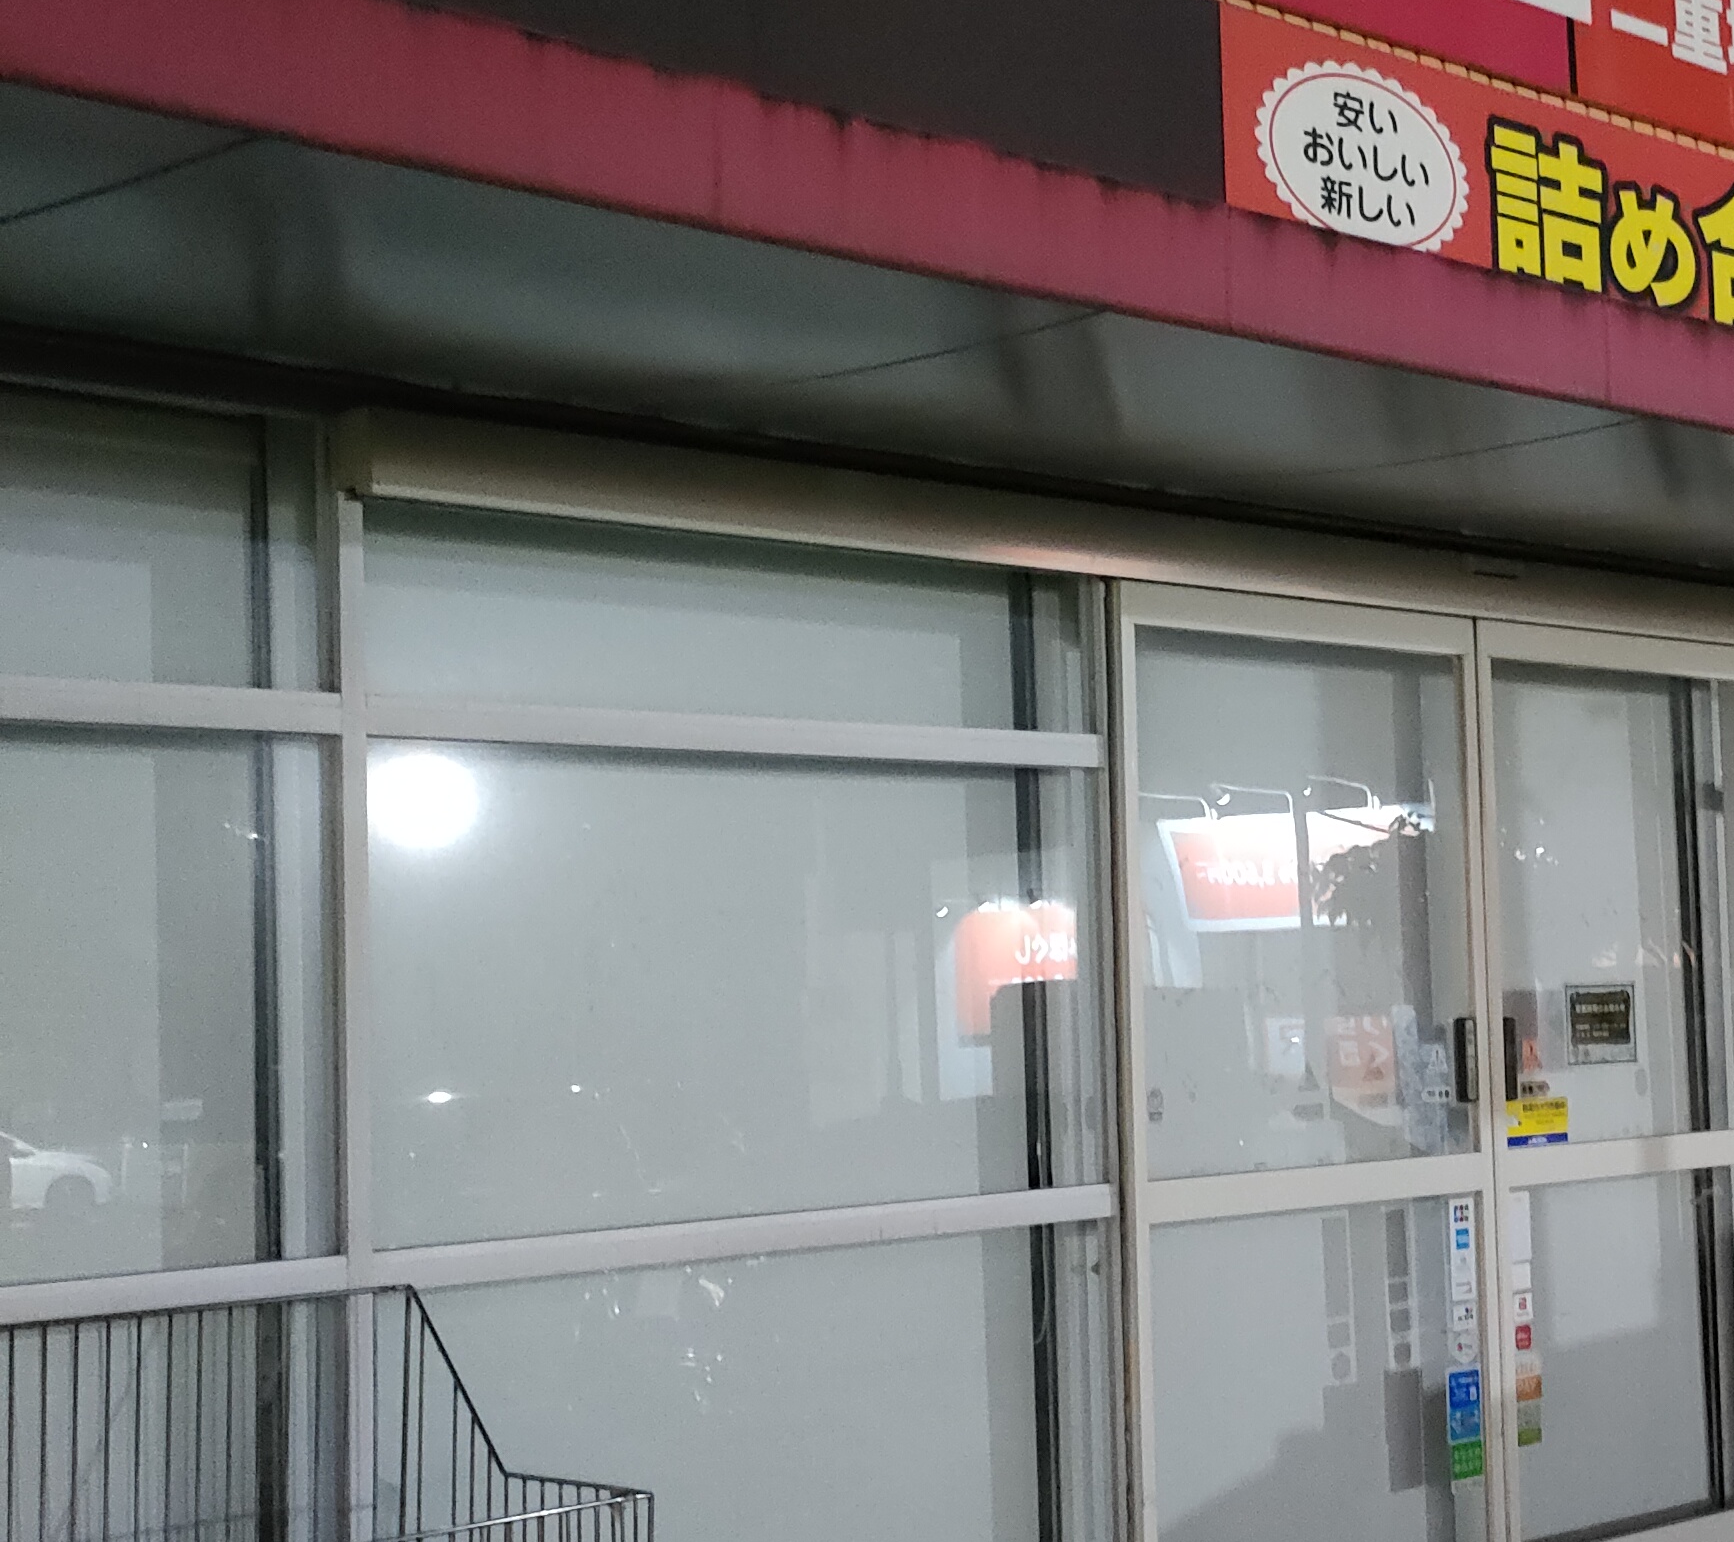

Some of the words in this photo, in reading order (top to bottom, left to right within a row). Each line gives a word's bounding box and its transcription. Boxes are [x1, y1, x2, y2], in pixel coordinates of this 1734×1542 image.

[1333, 91, 1398, 133] 安い
[1303, 126, 1430, 187] おいしい
[1320, 175, 1416, 228] 新しい
